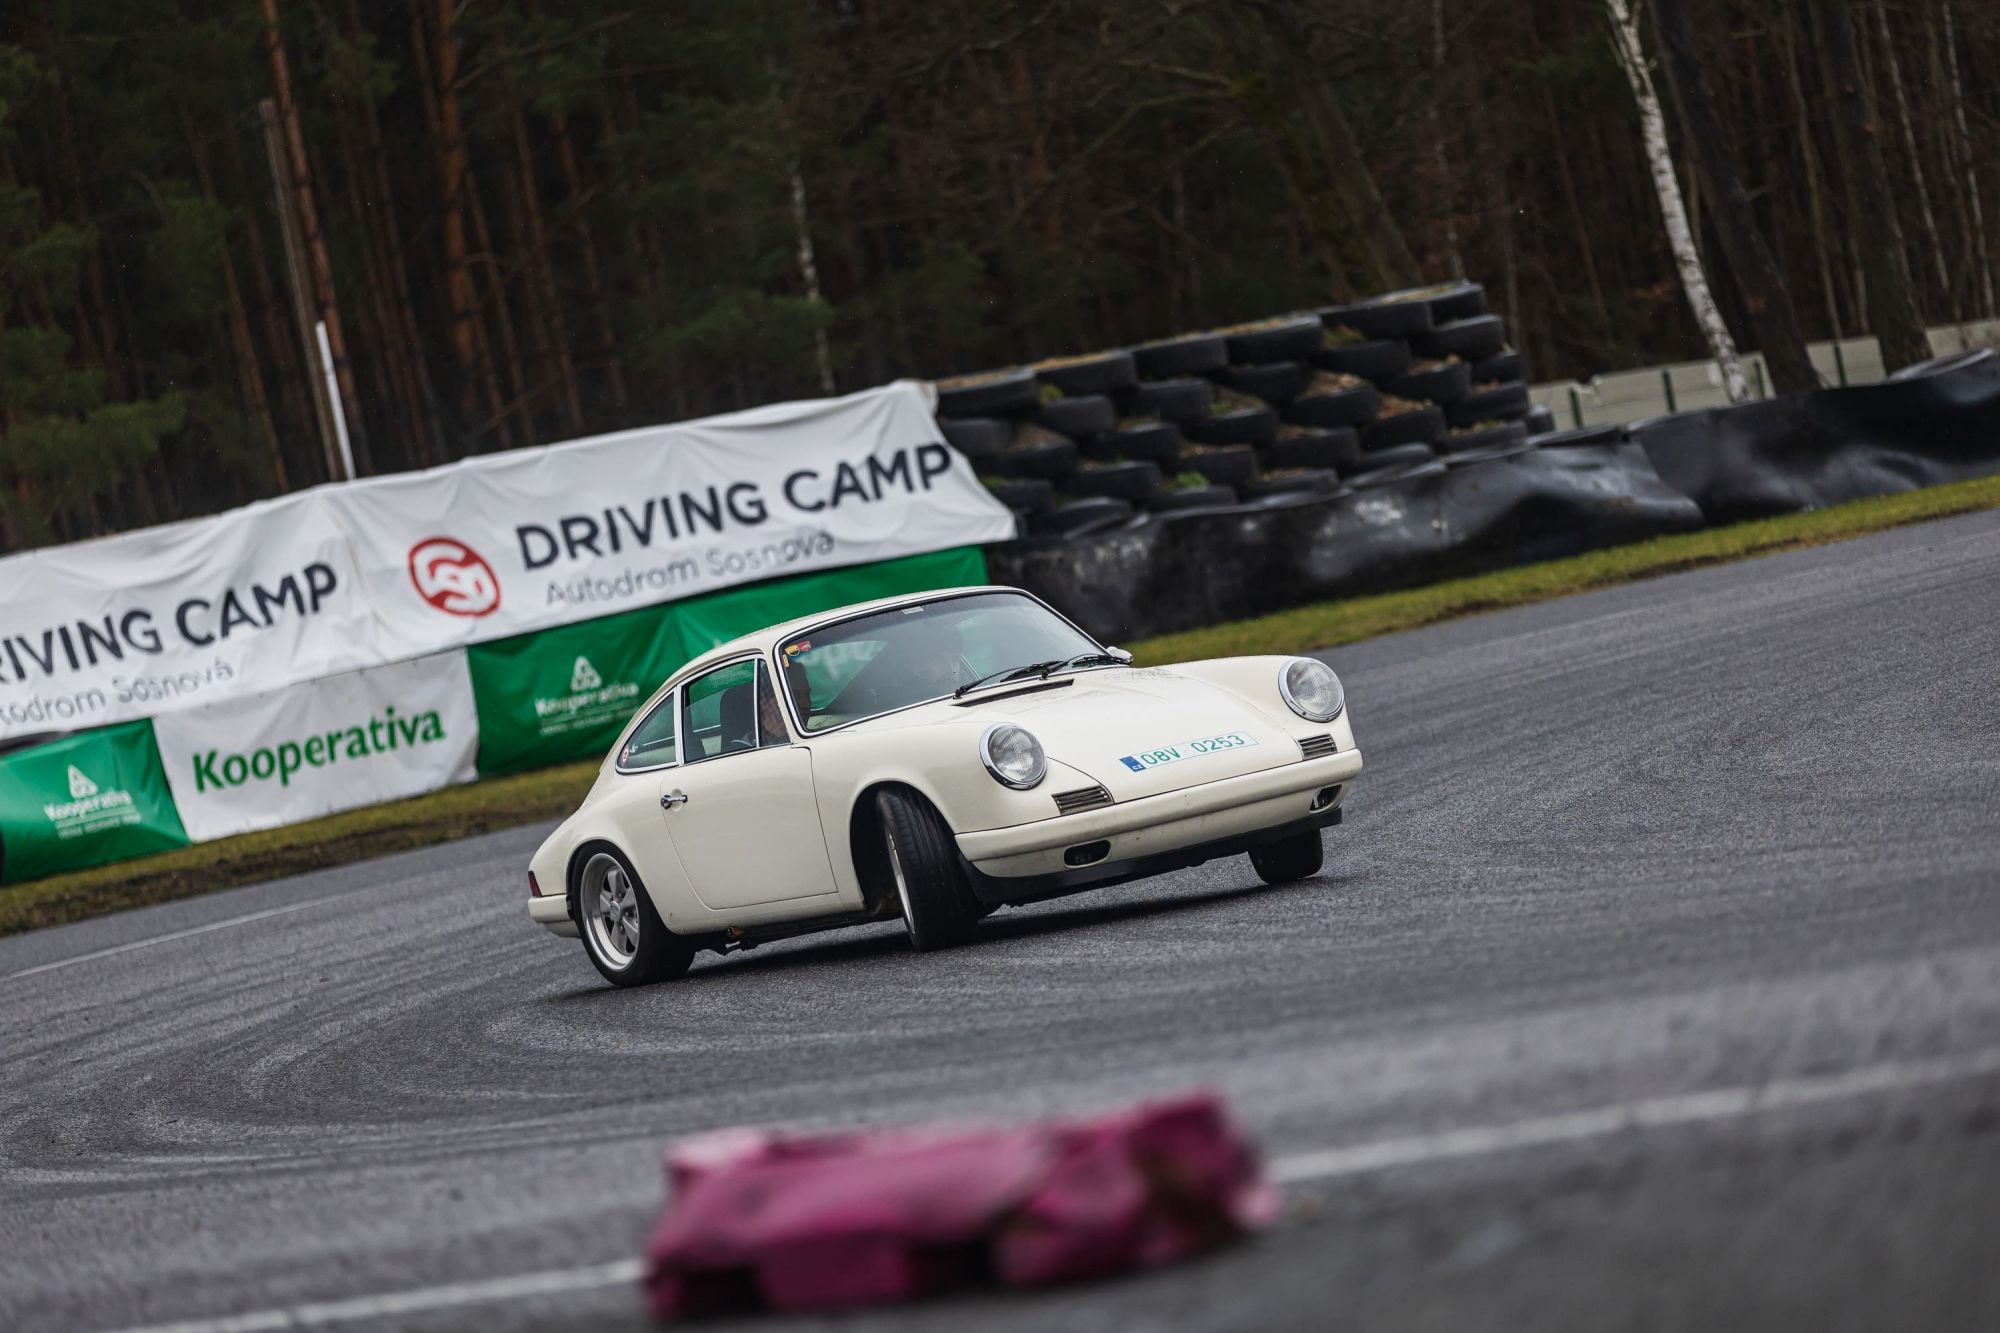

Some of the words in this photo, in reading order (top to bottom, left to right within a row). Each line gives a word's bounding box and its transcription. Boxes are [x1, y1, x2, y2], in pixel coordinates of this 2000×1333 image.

[515, 483, 768, 571] DRIVING
[783, 443, 951, 512] CAMP
[0, 608, 164, 684] IVING
[176, 562, 337, 647] CAMP
[546, 555, 699, 606] Autodrom
[192, 705, 446, 793] Kooperativa
[1140, 747, 1181, 765] 08V
[1190, 734, 1245, 753] 0253
